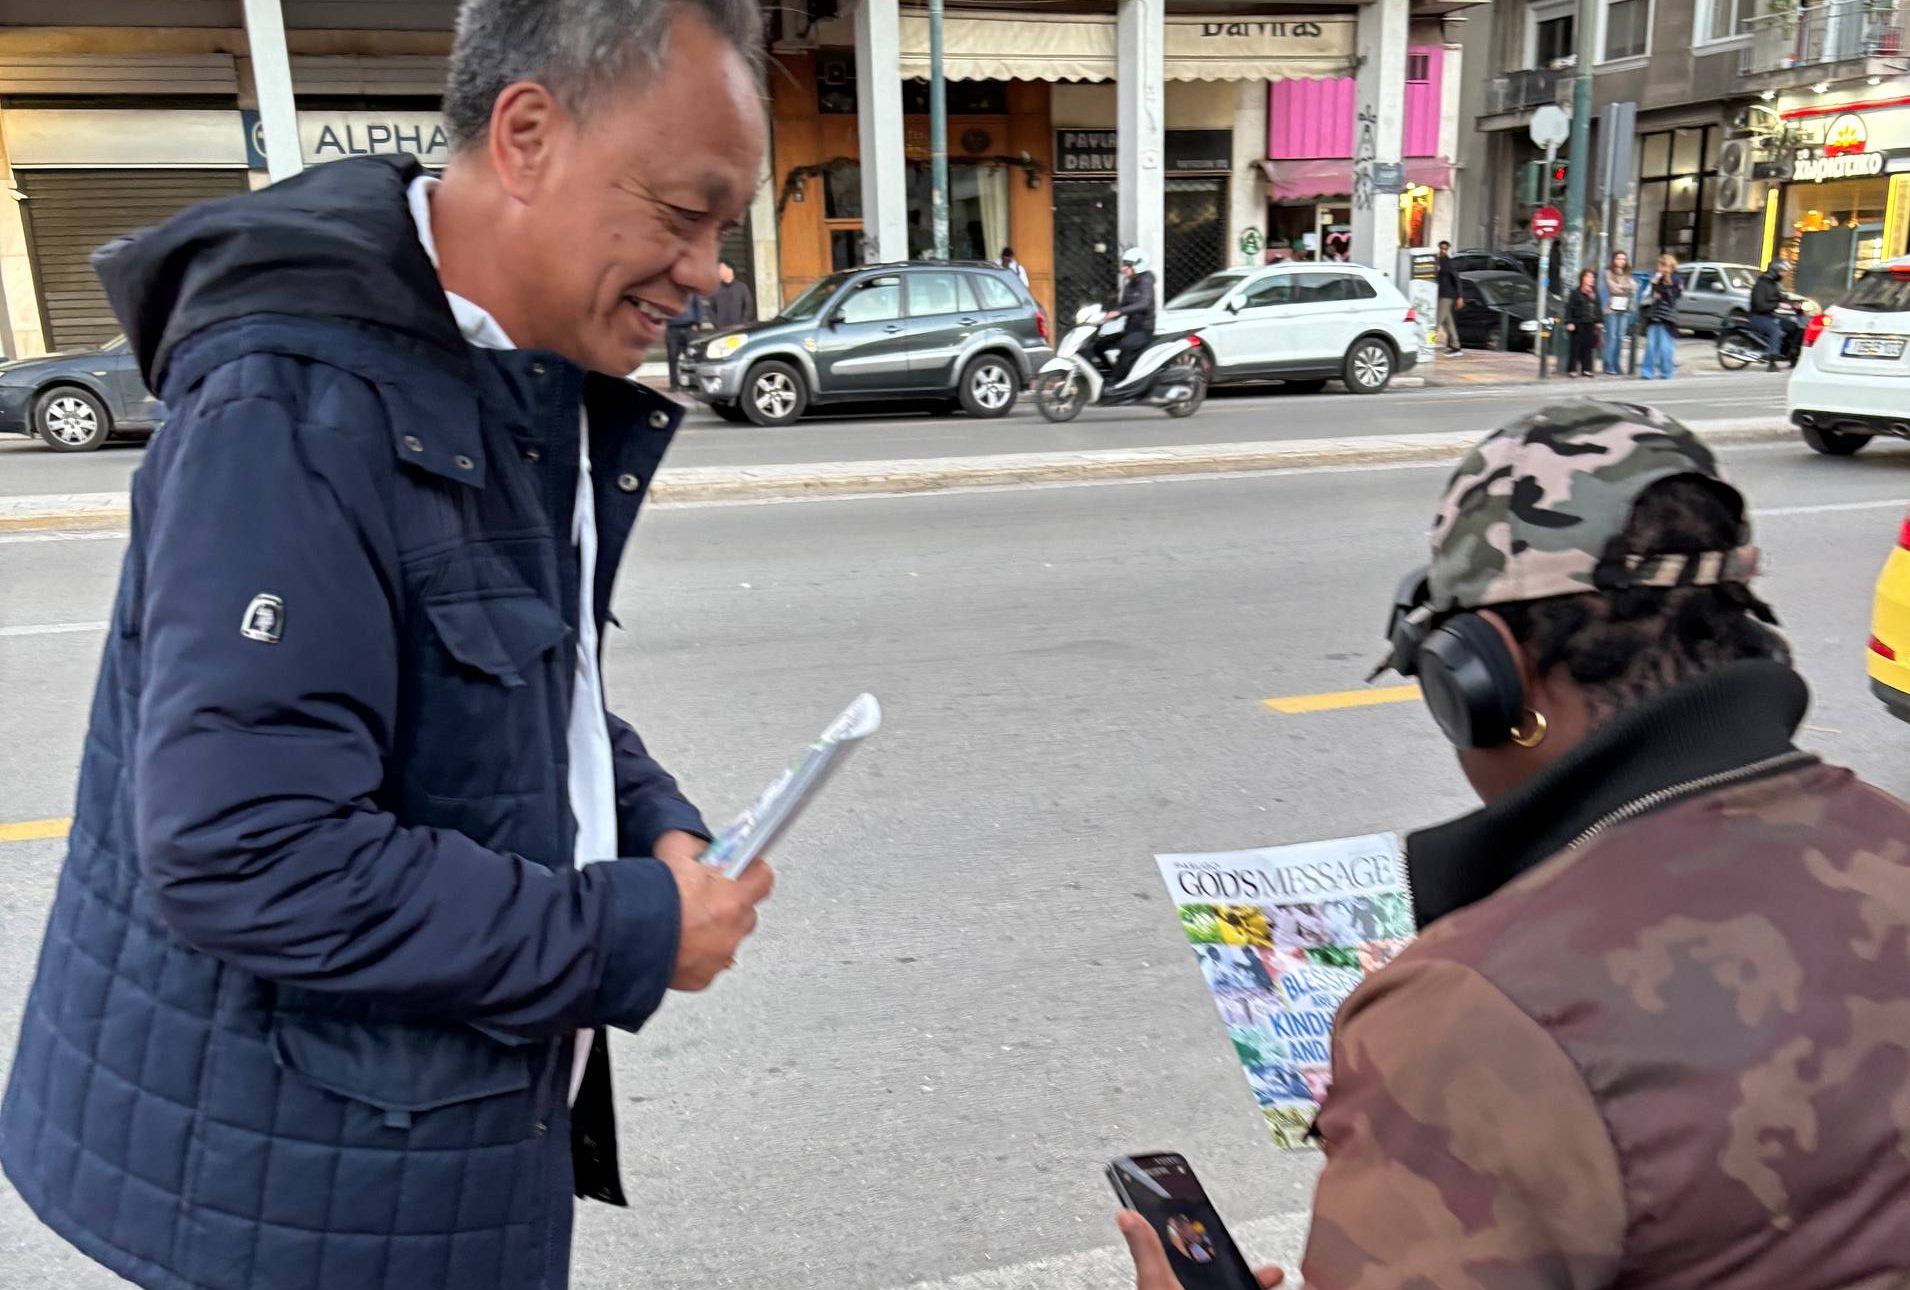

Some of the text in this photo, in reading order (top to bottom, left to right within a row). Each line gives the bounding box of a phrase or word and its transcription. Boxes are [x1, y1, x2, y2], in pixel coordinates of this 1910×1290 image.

[315, 125, 448, 154] ALPHA
[1064, 154, 1115, 169] DARV
[1289, 1039, 1330, 1063] AND
